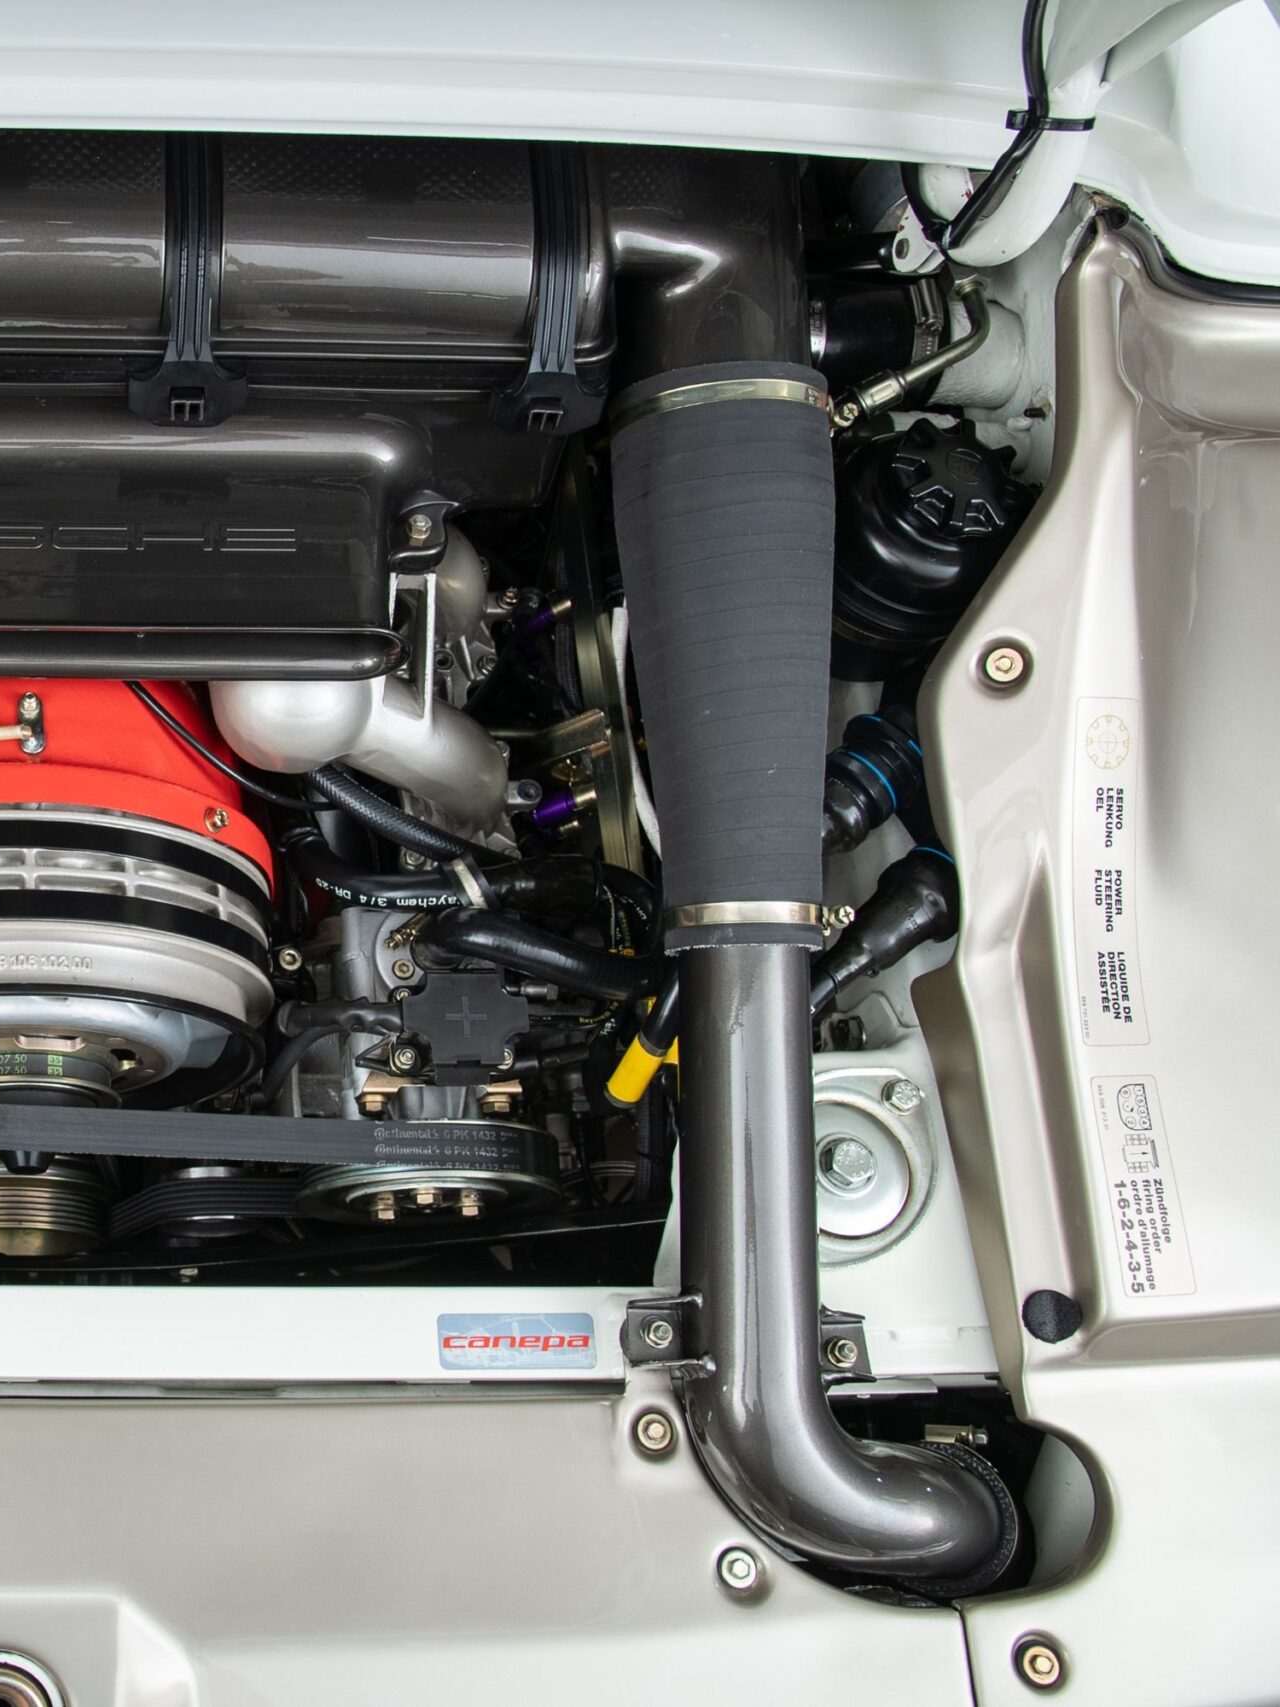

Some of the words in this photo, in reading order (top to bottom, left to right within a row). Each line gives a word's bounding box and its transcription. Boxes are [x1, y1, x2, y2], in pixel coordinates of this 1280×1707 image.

[1096, 787, 1104, 812] OEL
[1105, 787, 1114, 848] LENKUNG
[1115, 787, 1124, 830] SERVO
[396, 893, 461, 908] aychem
[1095, 869, 1103, 906] FLUID
[1104, 870, 1114, 932] STEERING
[1114, 870, 1123, 915] POWER
[1097, 951, 1112, 1013] ASSISTÉE
[1107, 951, 1122, 1020] DIRECTION
[1117, 951, 1130, 1002] LIQUIDE
[1123, 1006, 1133, 1023] DE
[1114, 1180, 1145, 1293] 1-6-2-4-3-5
[1130, 1180, 1142, 1215] ordre
[1138, 1219, 1156, 1290] d'allumage
[1142, 1179, 1154, 1214] firing
[1149, 1218, 1161, 1253] order
[1153, 1178, 1171, 1243] Zündfolge
[442, 1334, 590, 1351] canepa
